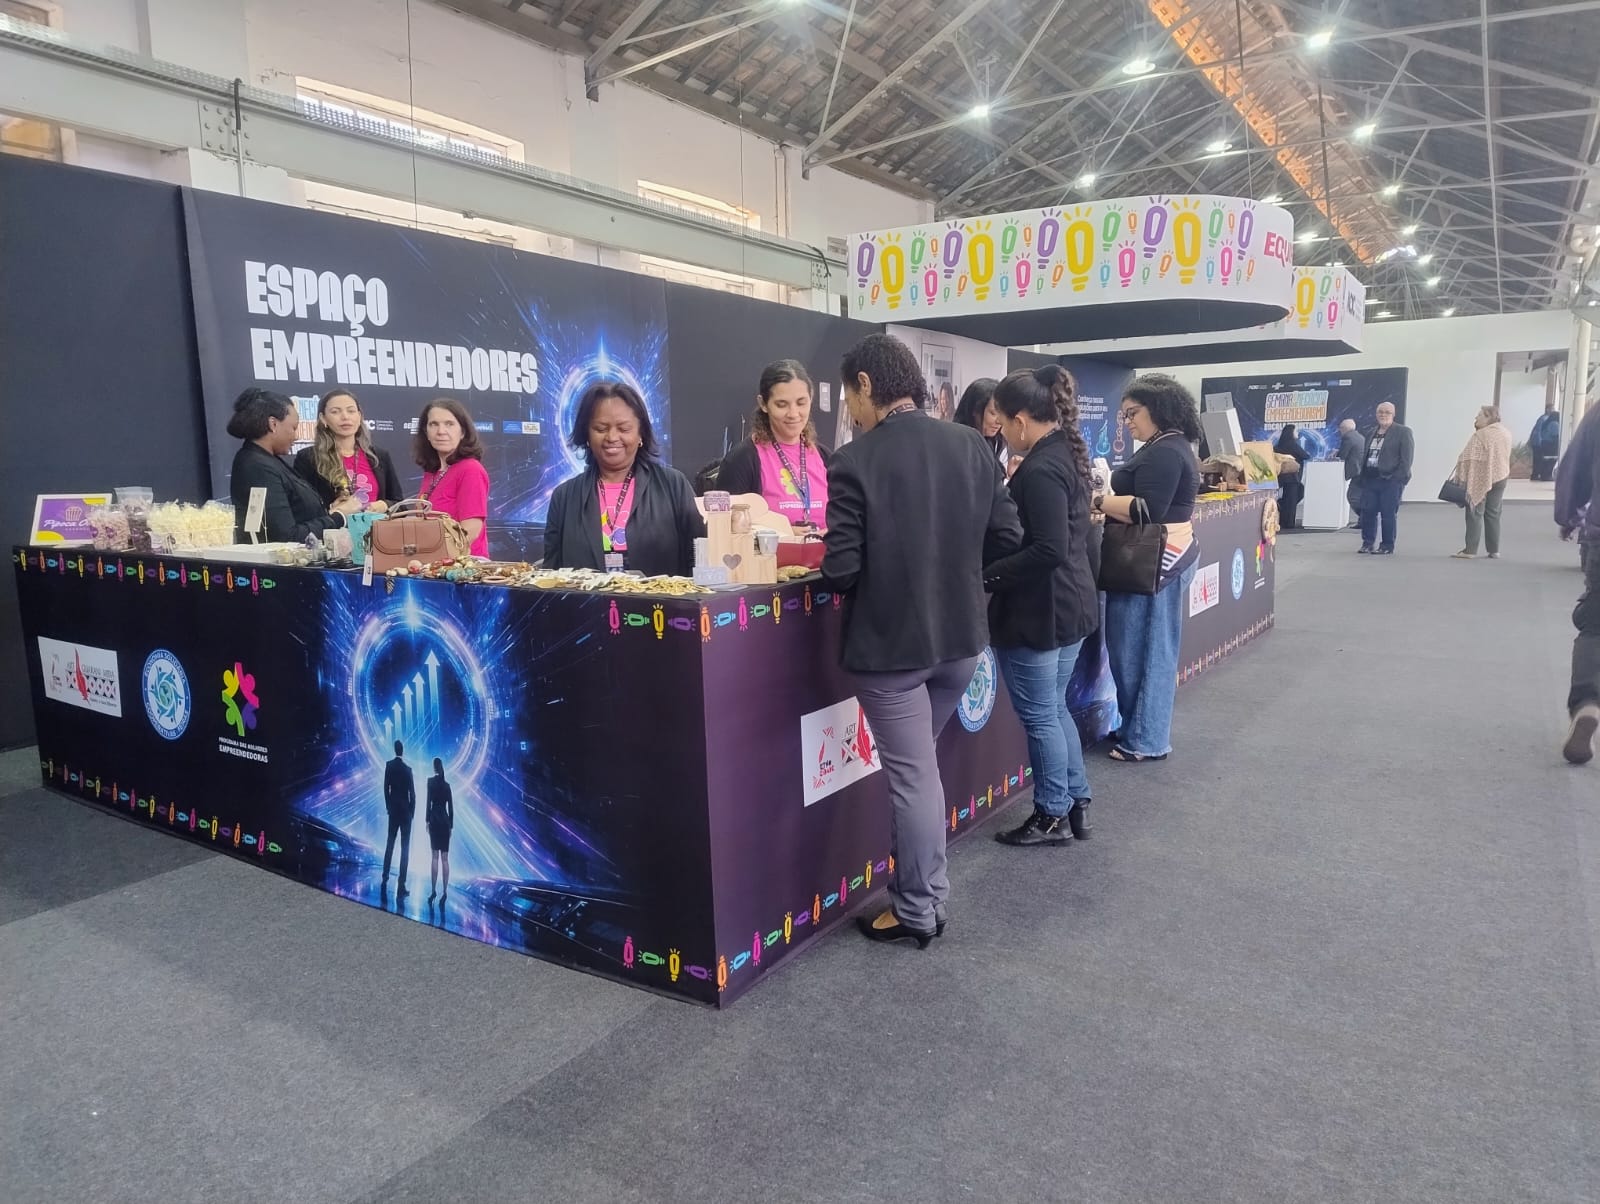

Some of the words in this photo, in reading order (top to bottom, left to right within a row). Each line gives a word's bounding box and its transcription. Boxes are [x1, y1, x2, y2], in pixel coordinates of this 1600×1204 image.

[245, 260, 389, 337] ESPAÇO
[250, 328, 538, 394] EMPREENDEDORES
[844, 722, 857, 738] ART
[219, 744, 268, 763] EMPREENDEDORAS
